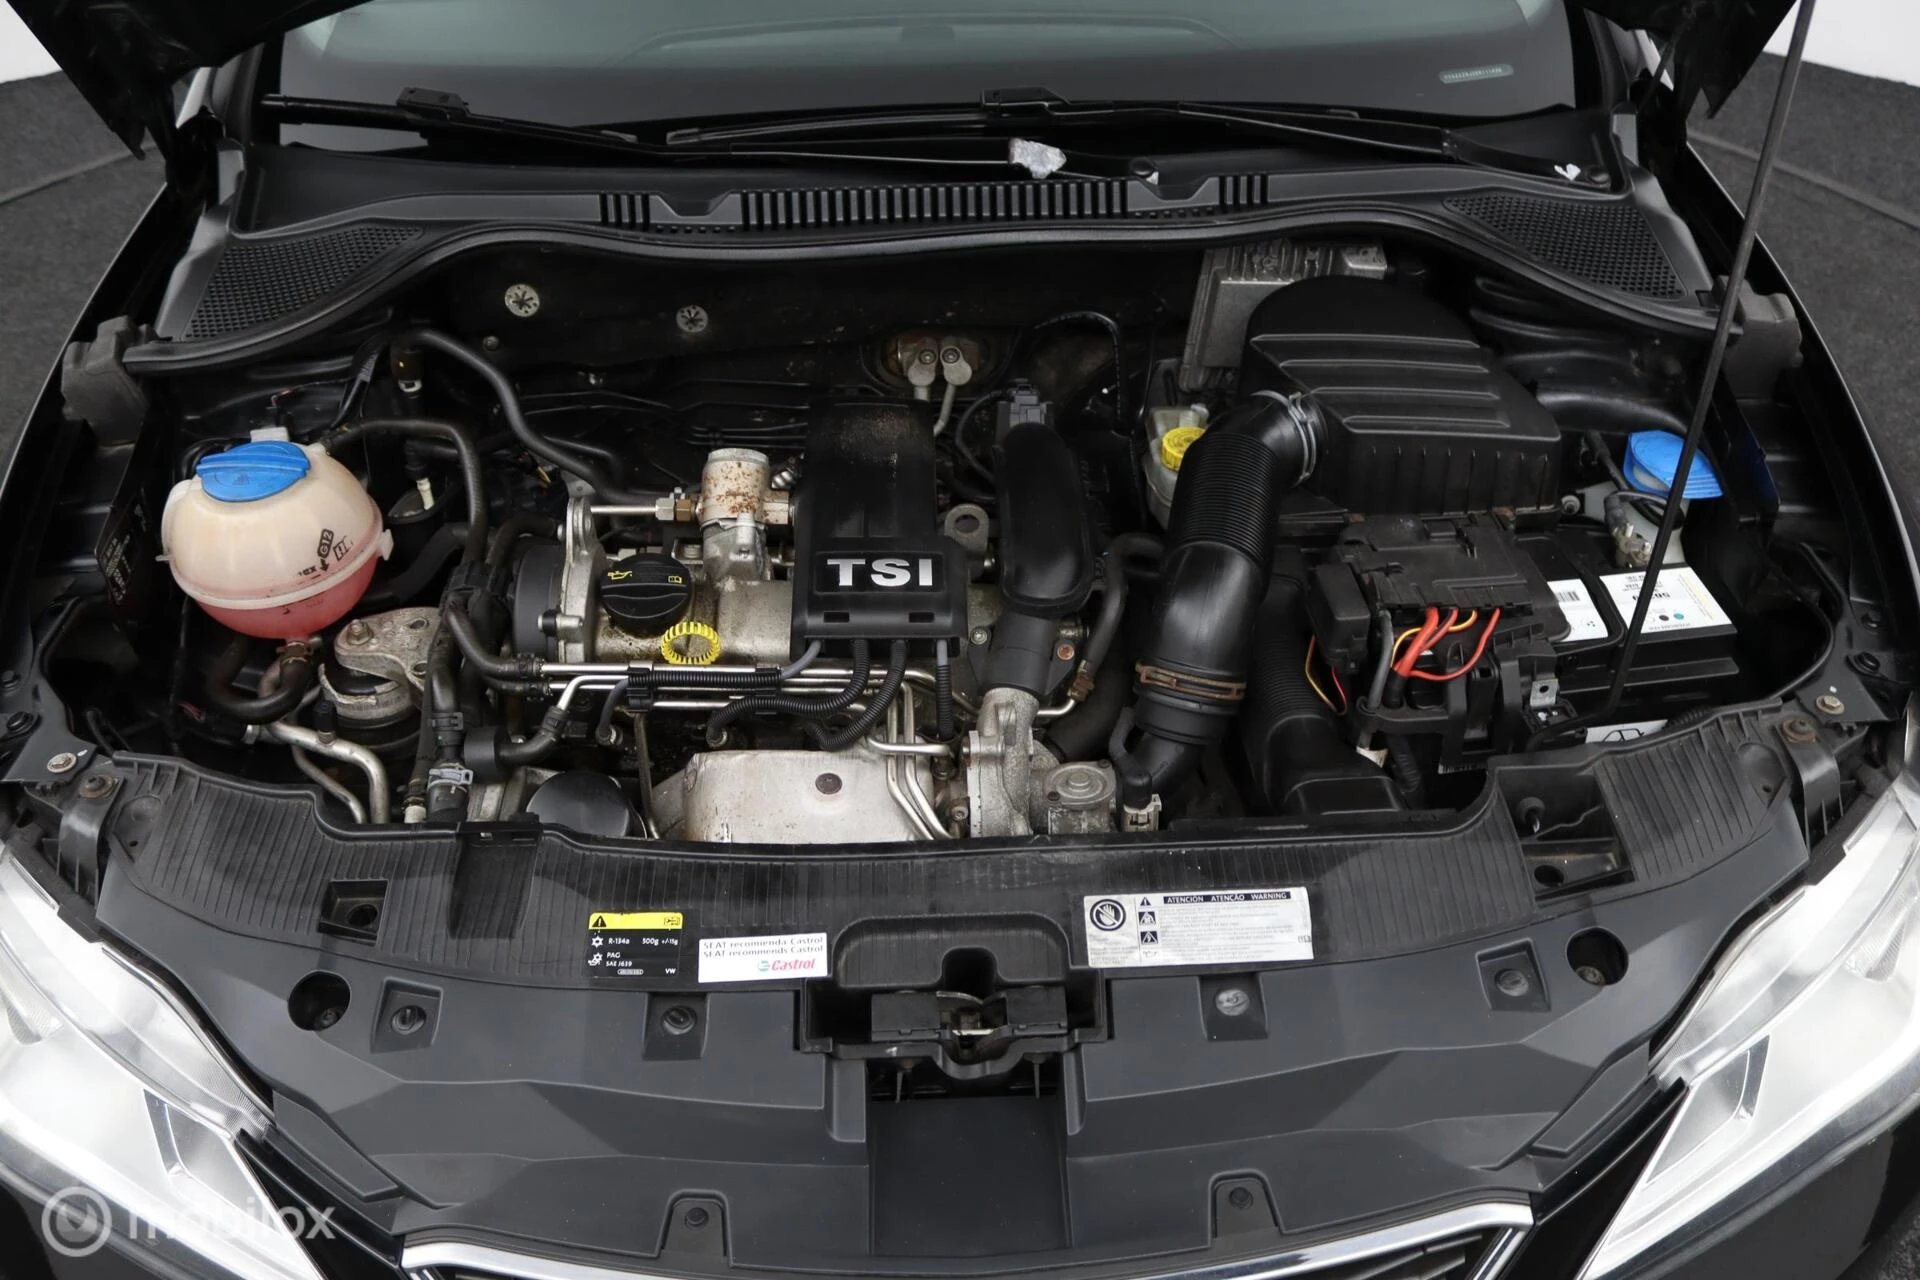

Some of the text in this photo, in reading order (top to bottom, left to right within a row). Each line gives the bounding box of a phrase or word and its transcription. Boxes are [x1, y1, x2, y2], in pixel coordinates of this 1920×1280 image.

[319, 531, 332, 556] G12
[827, 558, 933, 587] TSI
[1210, 893, 1245, 902] ATENÇÃO
[1251, 891, 1287, 900] WARNING
[608, 937, 630, 945] R-134a
[642, 937, 659, 946] 500g
[704, 936, 823, 950] SEAT recomienda Castrol
[606, 951, 621, 959] PAG
[704, 945, 823, 958] SEAT recommends Castrol
[618, 960, 633, 968] J639
[771, 958, 816, 972] Castrol
